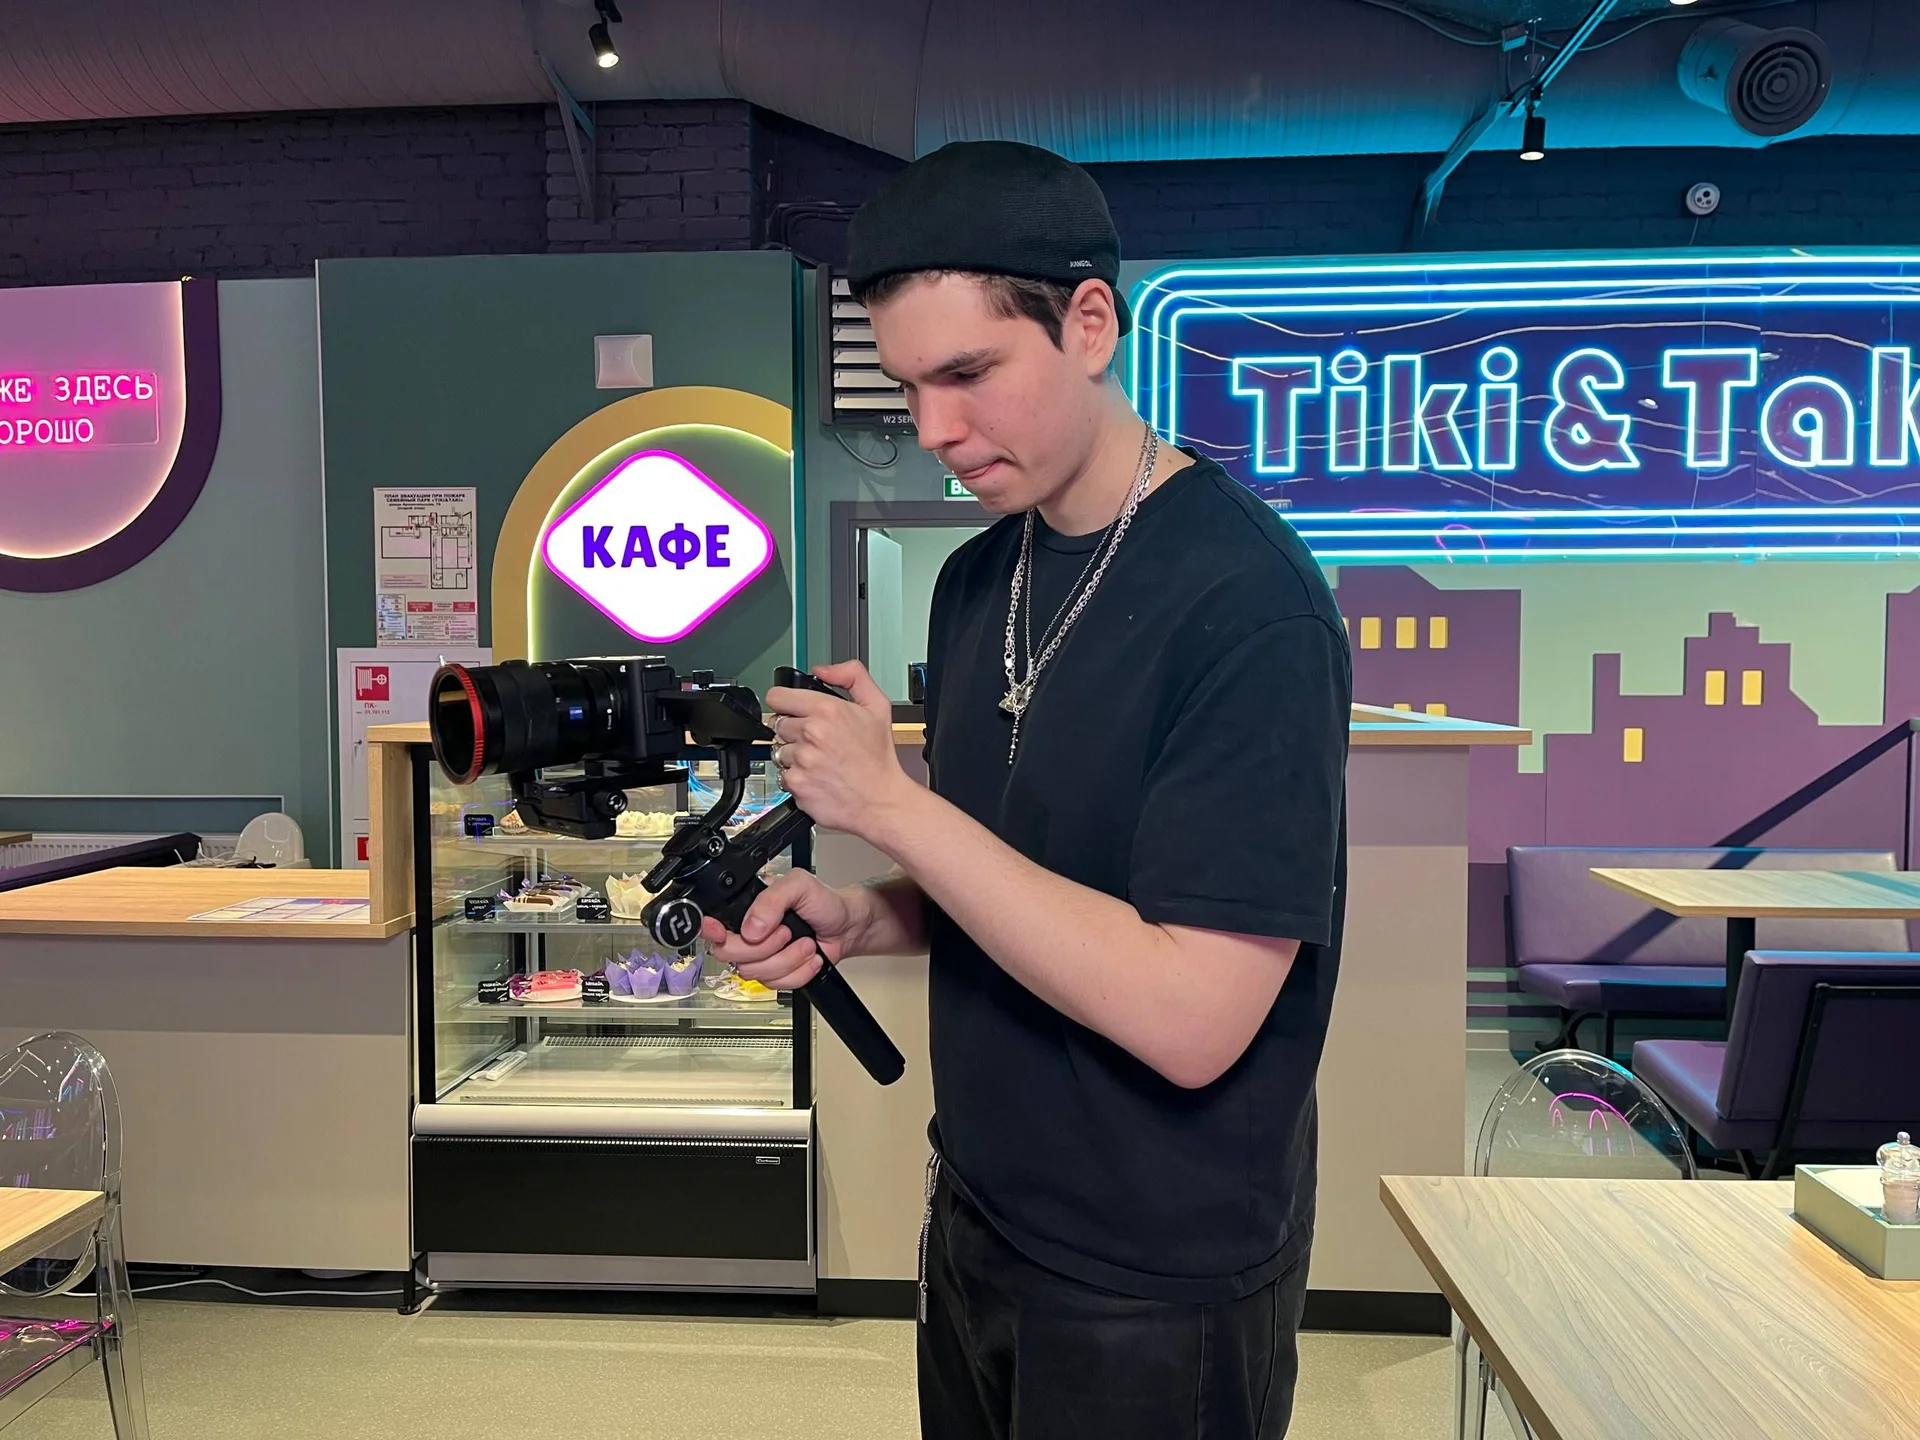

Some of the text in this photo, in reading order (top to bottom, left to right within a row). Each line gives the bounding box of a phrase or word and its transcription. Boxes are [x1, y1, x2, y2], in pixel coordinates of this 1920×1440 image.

[54, 375, 154, 406] ЗДЕСЬ
[1231, 345, 1520, 474] Tiki
[1544, 346, 1641, 473] &
[582, 523, 731, 570] КАФЕ
